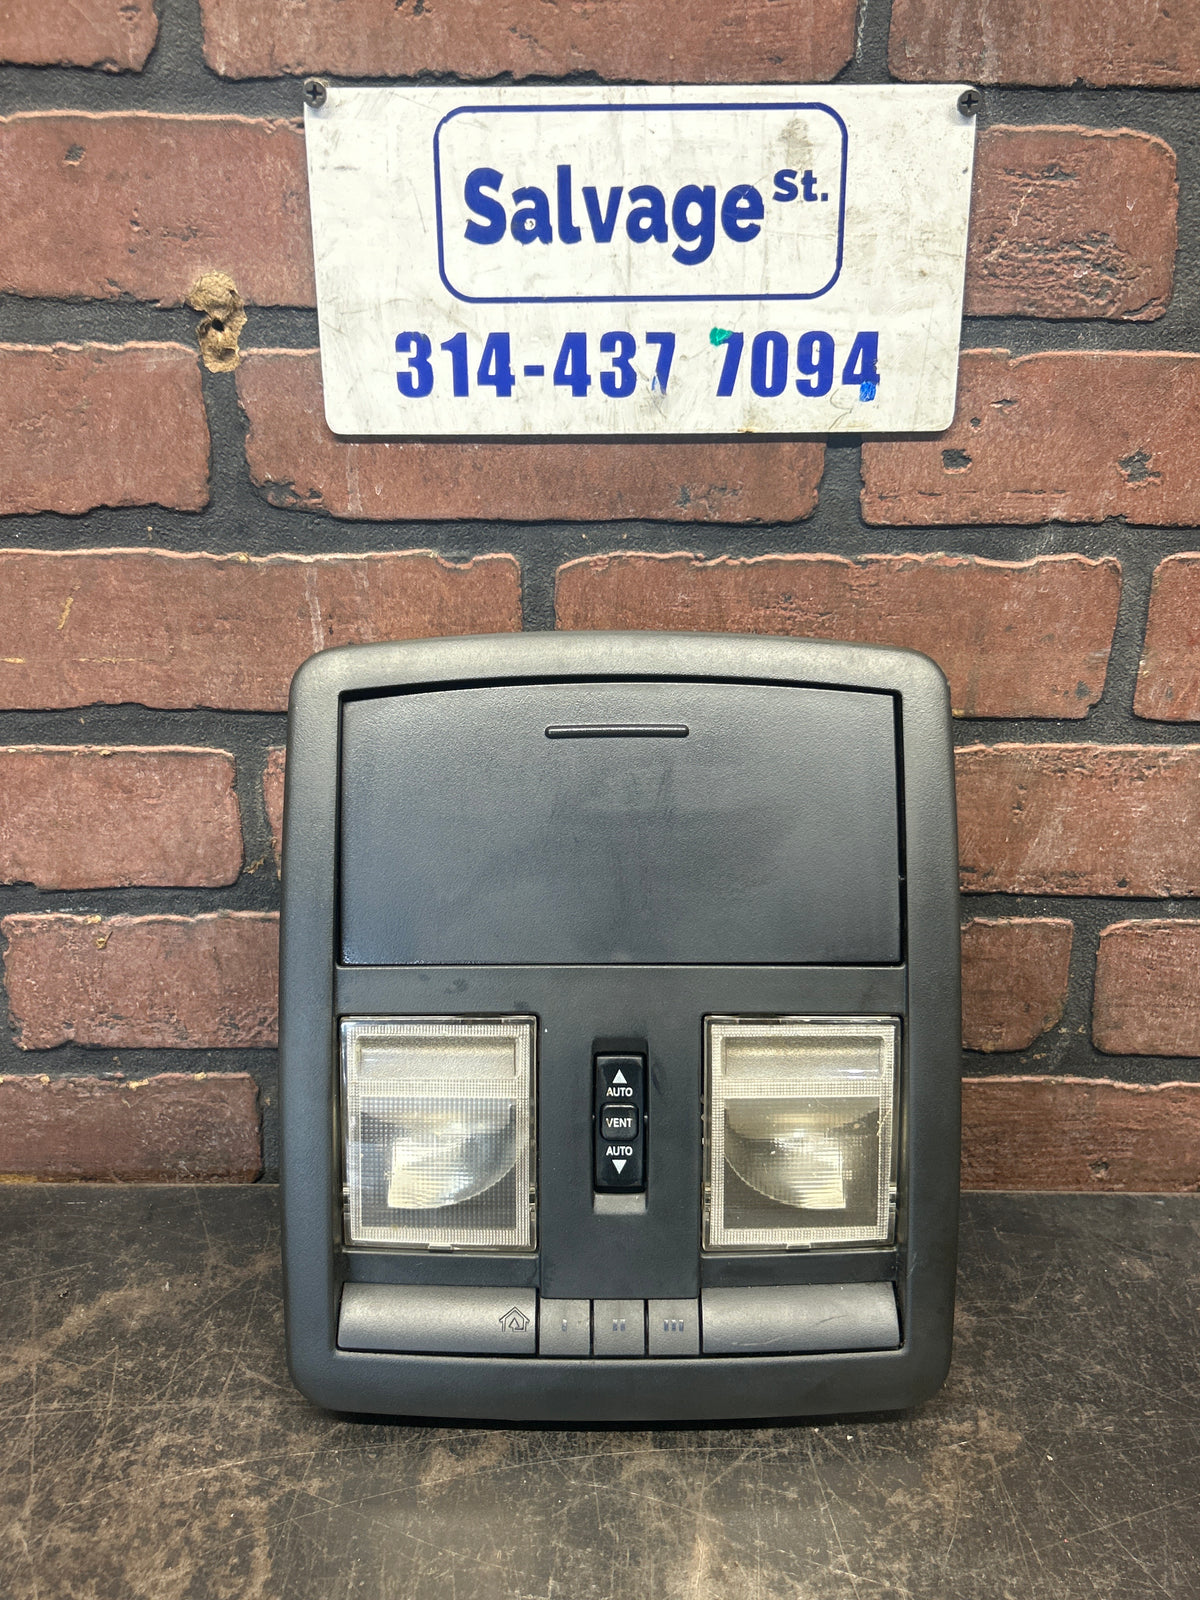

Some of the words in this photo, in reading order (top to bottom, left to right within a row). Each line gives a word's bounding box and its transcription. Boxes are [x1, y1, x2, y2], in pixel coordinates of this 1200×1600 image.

[464, 164, 766, 266] Salvage
[772, 168, 830, 203] St.
[395, 331, 677, 399] 314-437
[711, 330, 880, 399] 7094
[606, 1086, 634, 1097] AUTO
[605, 1117, 633, 1128] VENT
[605, 1145, 634, 1157] AUTO
